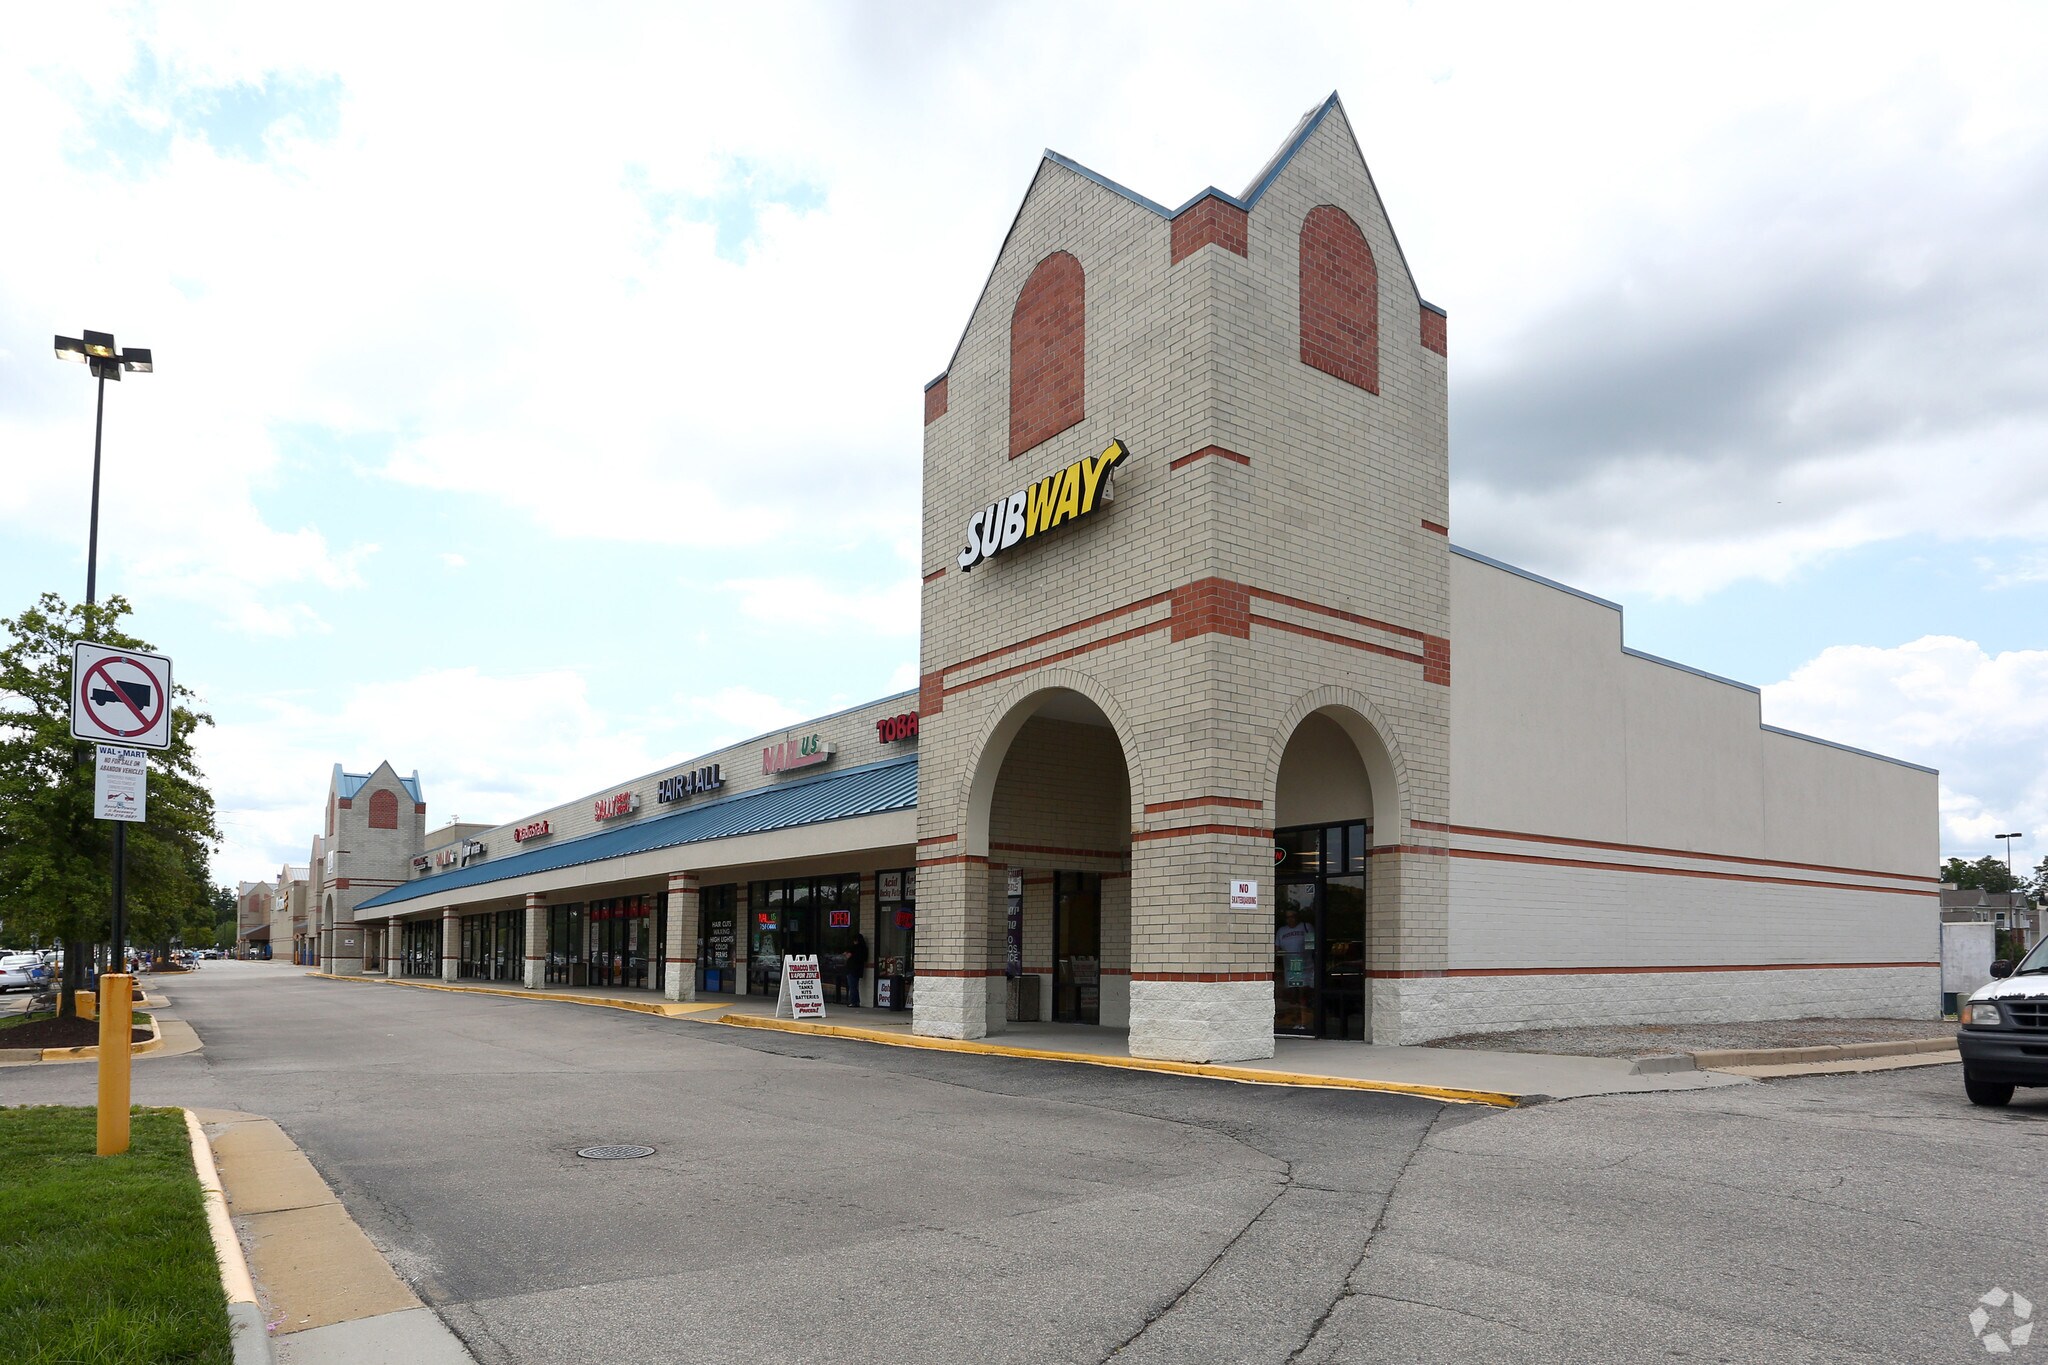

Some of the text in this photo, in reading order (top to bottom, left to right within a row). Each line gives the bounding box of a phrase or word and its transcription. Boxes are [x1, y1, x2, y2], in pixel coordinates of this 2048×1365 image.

[956, 438, 1130, 572] SUBWAY
[99, 746, 146, 758] WAL MART
[762, 733, 828, 775] NAIL US
[100, 765, 144, 775] ABANDON VEHICLES
[658, 764, 720, 804] HAIR 4 ALL
[884, 876, 898, 887] Acid
[1239, 884, 1249, 893] NO
[1231, 896, 1257, 905] SKATEBOARDING
